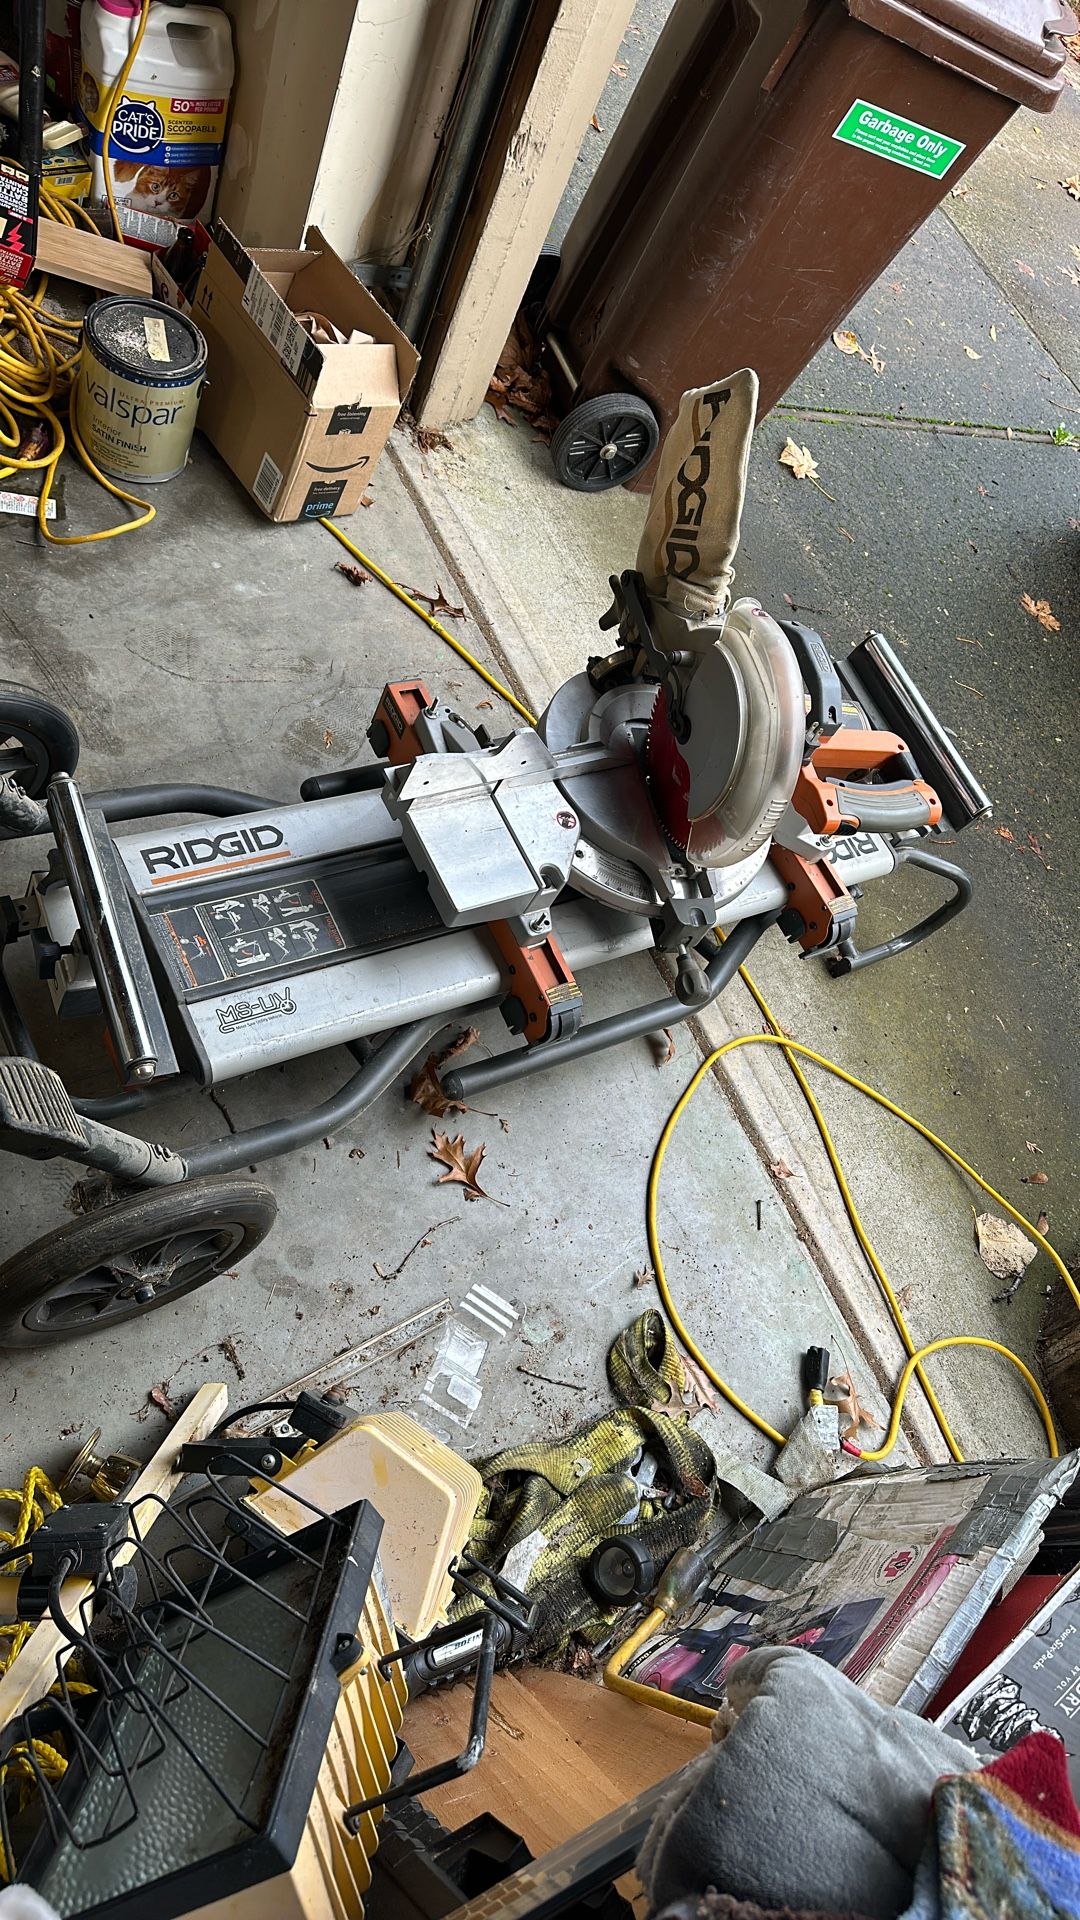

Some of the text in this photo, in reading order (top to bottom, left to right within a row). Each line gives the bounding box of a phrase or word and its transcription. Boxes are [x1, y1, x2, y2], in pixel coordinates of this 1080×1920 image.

[112, 120, 159, 143] PRIDE
[118, 109, 154, 126] CAT'S
[167, 124, 217, 133] SCOOPABLE
[858, 110, 948, 159] Garbage Only
[85, 371, 182, 428] valspar
[91, 424, 147, 453] SATIN FINISH
[305, 501, 334, 512] prime
[139, 824, 284, 875] RIDGID
[215, 986, 292, 1027] MS-UV
[1032, 1623, 1078, 1672] Four Six-Packs
